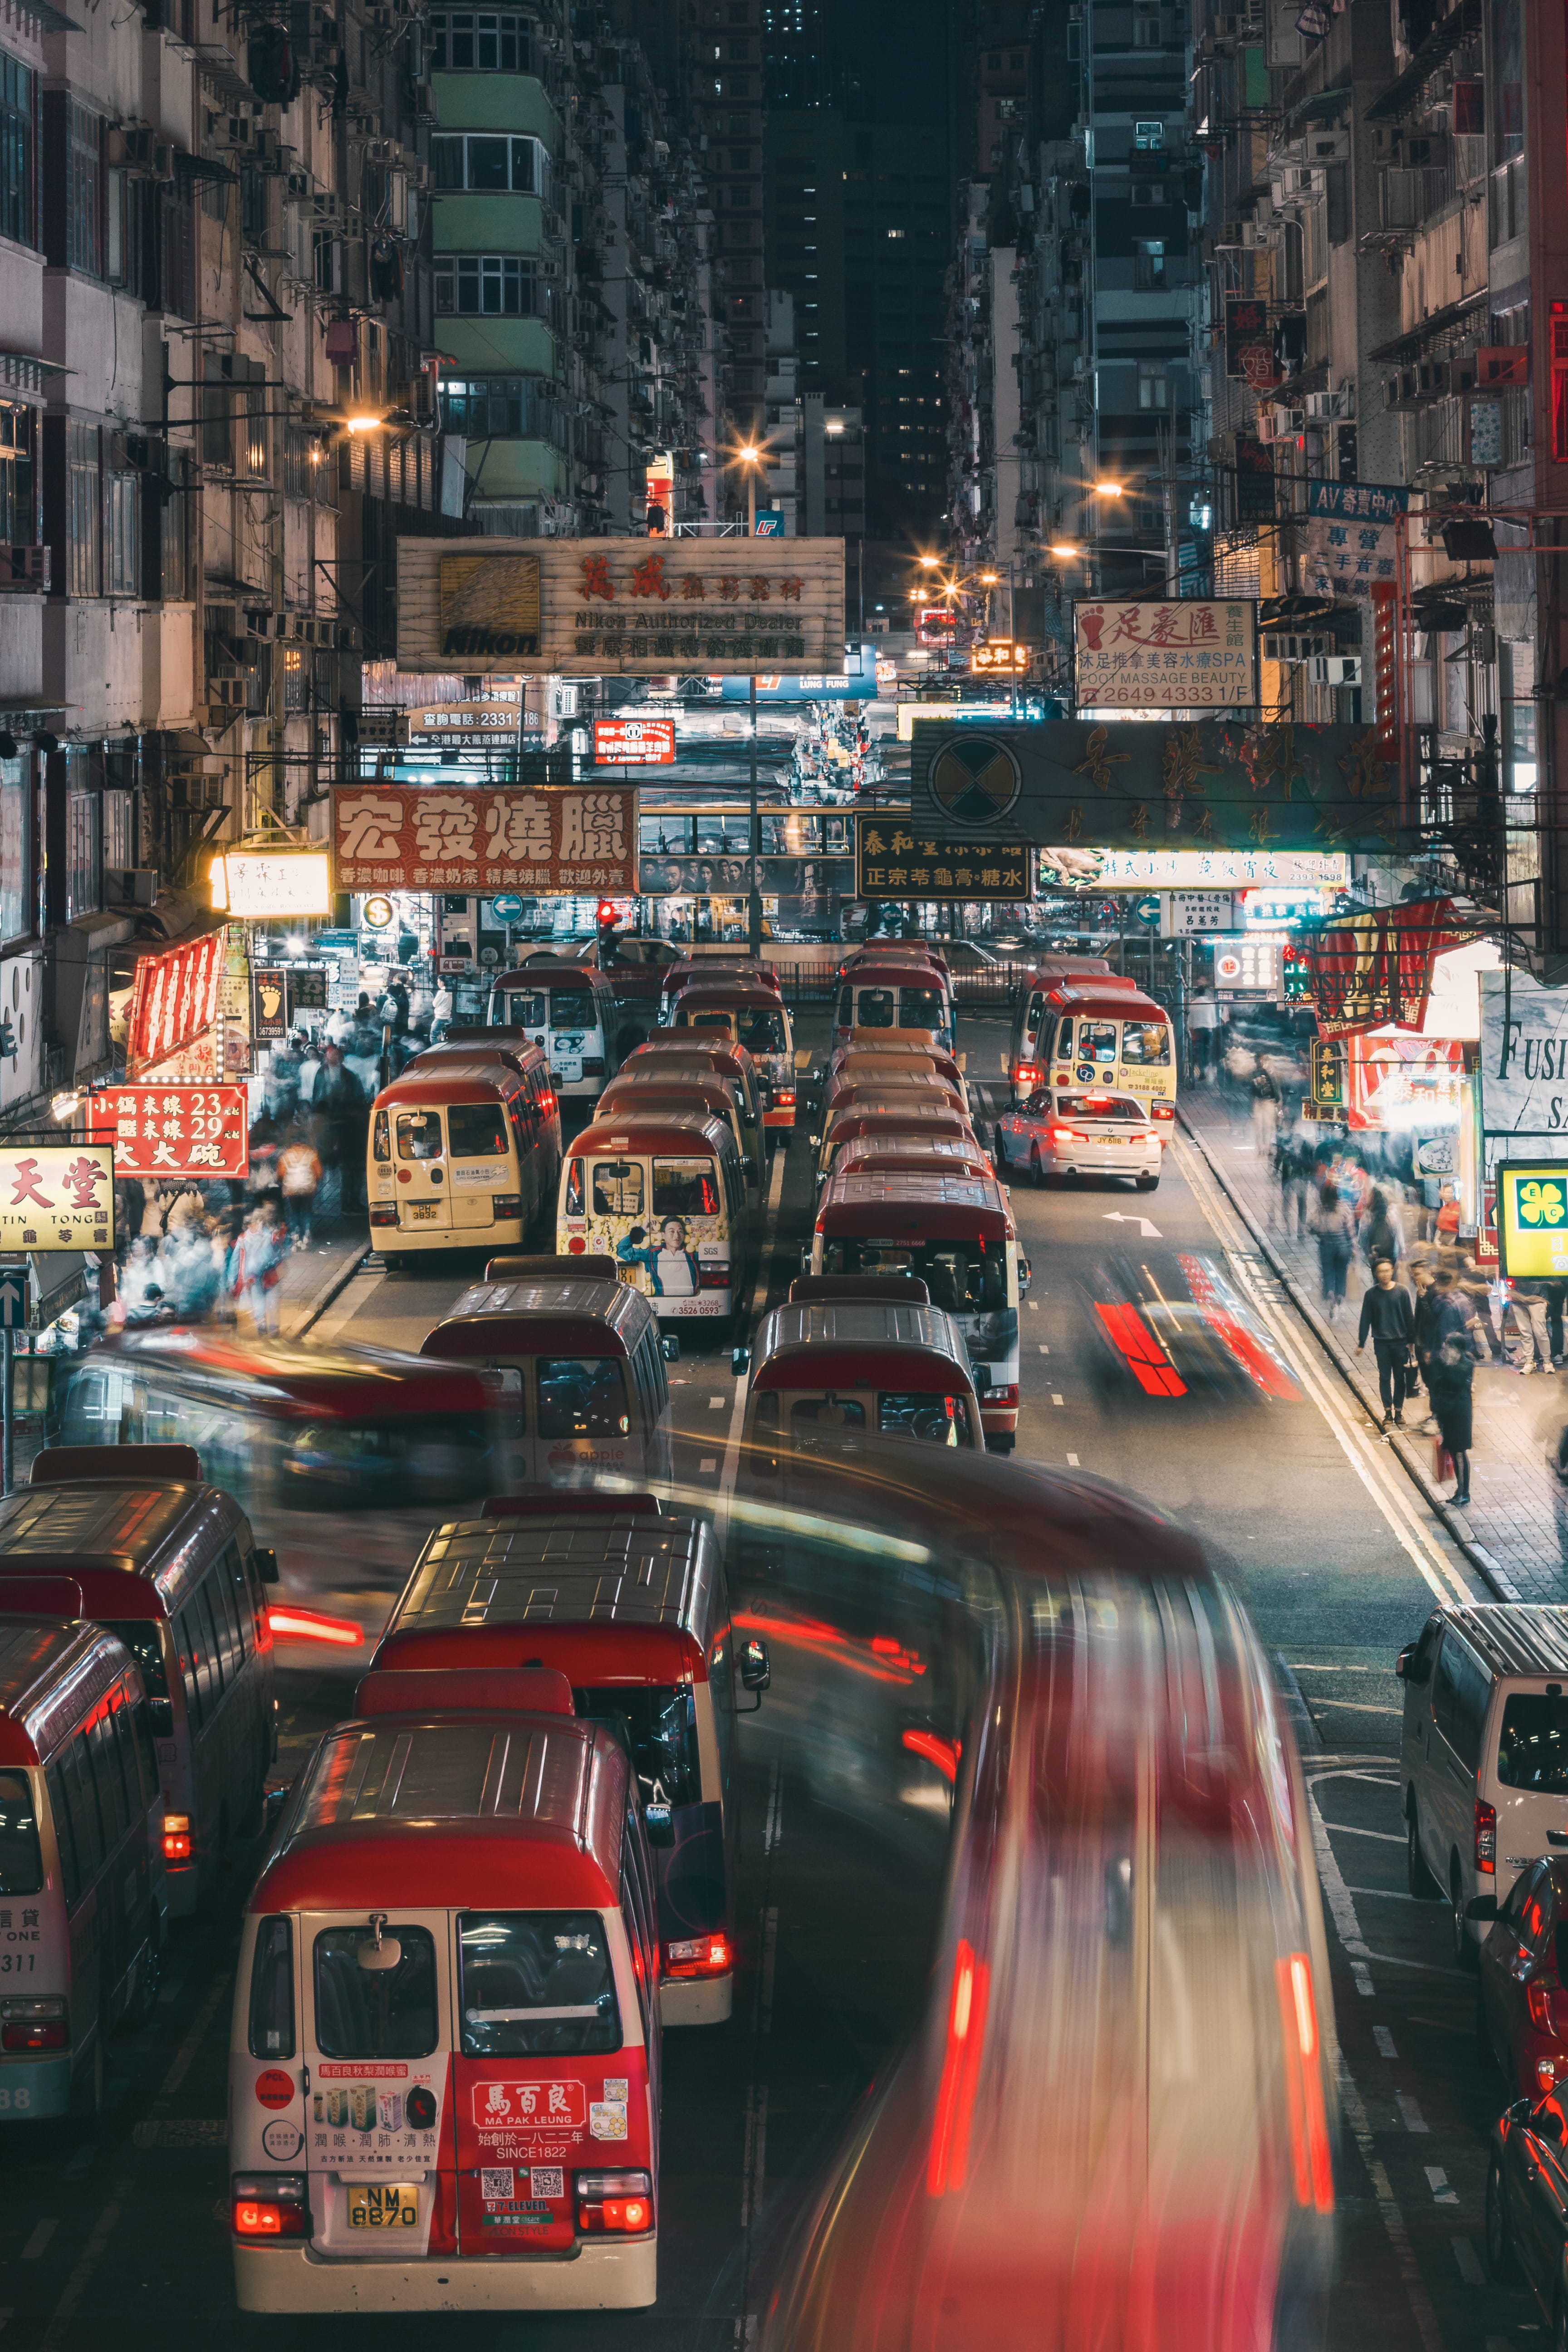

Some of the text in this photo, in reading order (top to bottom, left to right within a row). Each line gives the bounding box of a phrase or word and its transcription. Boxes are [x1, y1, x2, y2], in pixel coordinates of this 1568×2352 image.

[1327, 525, 1380, 550] 專營
[1314, 551, 1395, 575] 二手音響
[575, 611, 803, 630] Nikon Authorized Dealer
[1225, 604, 1244, 647] 養生館
[443, 629, 538, 655] Nikon
[1080, 652, 1246, 669] 沐足推拿美容水療SPA
[800, 680, 849, 689] LUNG FUNG
[1080, 672, 1246, 684] FOOT MASSAGE BEAUTY
[1104, 686, 1248, 701] 2649 4333 1/F
[340, 867, 405, 884] 香濃咖啡
[413, 867, 479, 884] 香濃奶茶
[559, 868, 624, 885] 歡迎外賣
[1548, 1097, 1568, 1129] S
[114, 1140, 226, 1168] 大大碗
[10, 1156, 108, 1209] 天堂
[2, 1215, 27, 1225] TIN
[51, 1215, 93, 1224] TONG
[23, 1229, 108, 1243] 龜苓膏
[704, 1247, 718, 1255] SGS
[579, 1448, 624, 1462] apple
[6, 1931, 40, 1941] ONE
[321, 2065, 407, 2077] 馬百良秋梨潤喉蜜
[485, 2084, 571, 2117] 馬百良
[534, 2115, 572, 2124] LEUNG
[478, 2131, 583, 2146] 始創於一八二二年
[368, 2188, 400, 2207] NM
[352, 2206, 416, 2225] 8870
[494, 2215, 520, 2224] 華潤堂
[518, 2226, 549, 2235] STYLE
